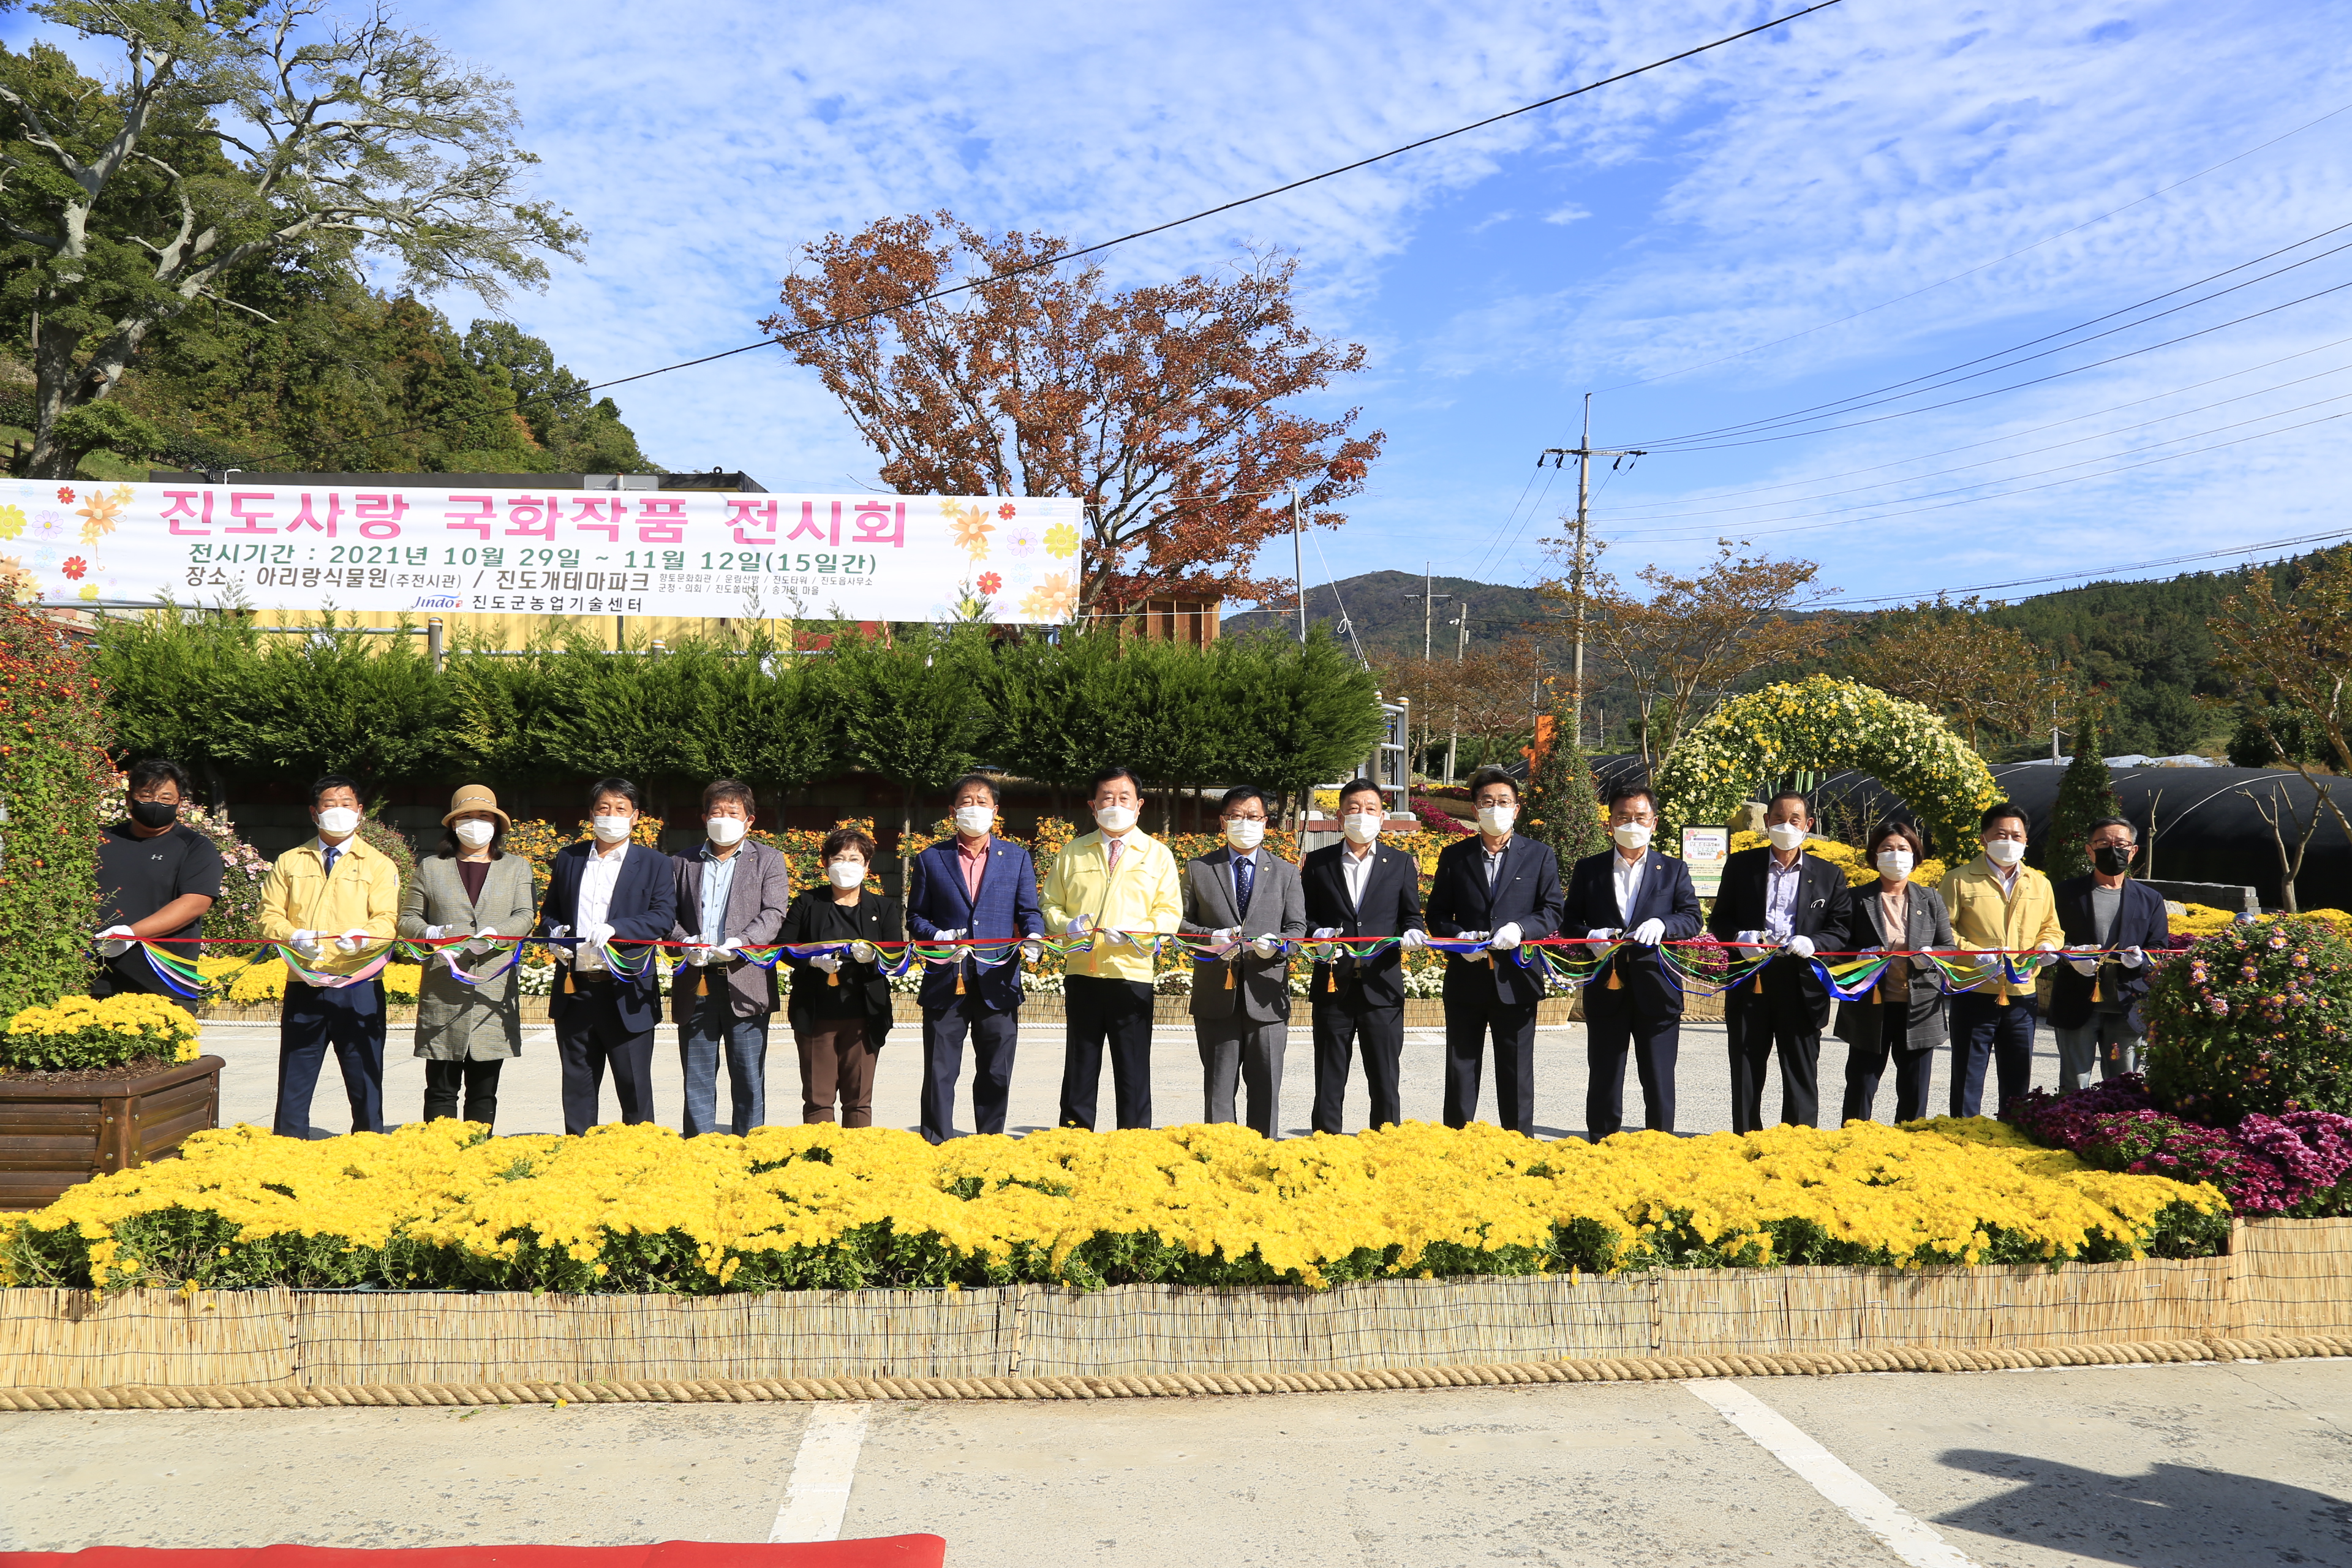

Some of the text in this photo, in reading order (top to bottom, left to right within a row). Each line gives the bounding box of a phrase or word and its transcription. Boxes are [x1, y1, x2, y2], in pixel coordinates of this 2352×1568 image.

[159, 491, 905, 548] 진도사랑 국화작품 전시회
[189, 544, 295, 564] 전시기간
[309, 548, 315, 560] :
[330, 546, 427, 565] 2021년
[444, 548, 503, 567] 10월
[519, 549, 579, 568] 29일
[624, 550, 685, 571] 11월
[186, 566, 227, 587] 장소
[473, 570, 484, 588] /
[497, 571, 649, 592] 진도개테마파크
[660, 574, 711, 582] 향토문화회관
[725, 575, 760, 584] 운림산방
[659, 584, 674, 592] 군청
[772, 586, 798, 595] 송가인
[803, 586, 818, 595] 마을
[412, 596, 454, 608] Jindo
[472, 595, 642, 612] 진도군농업기술센터
